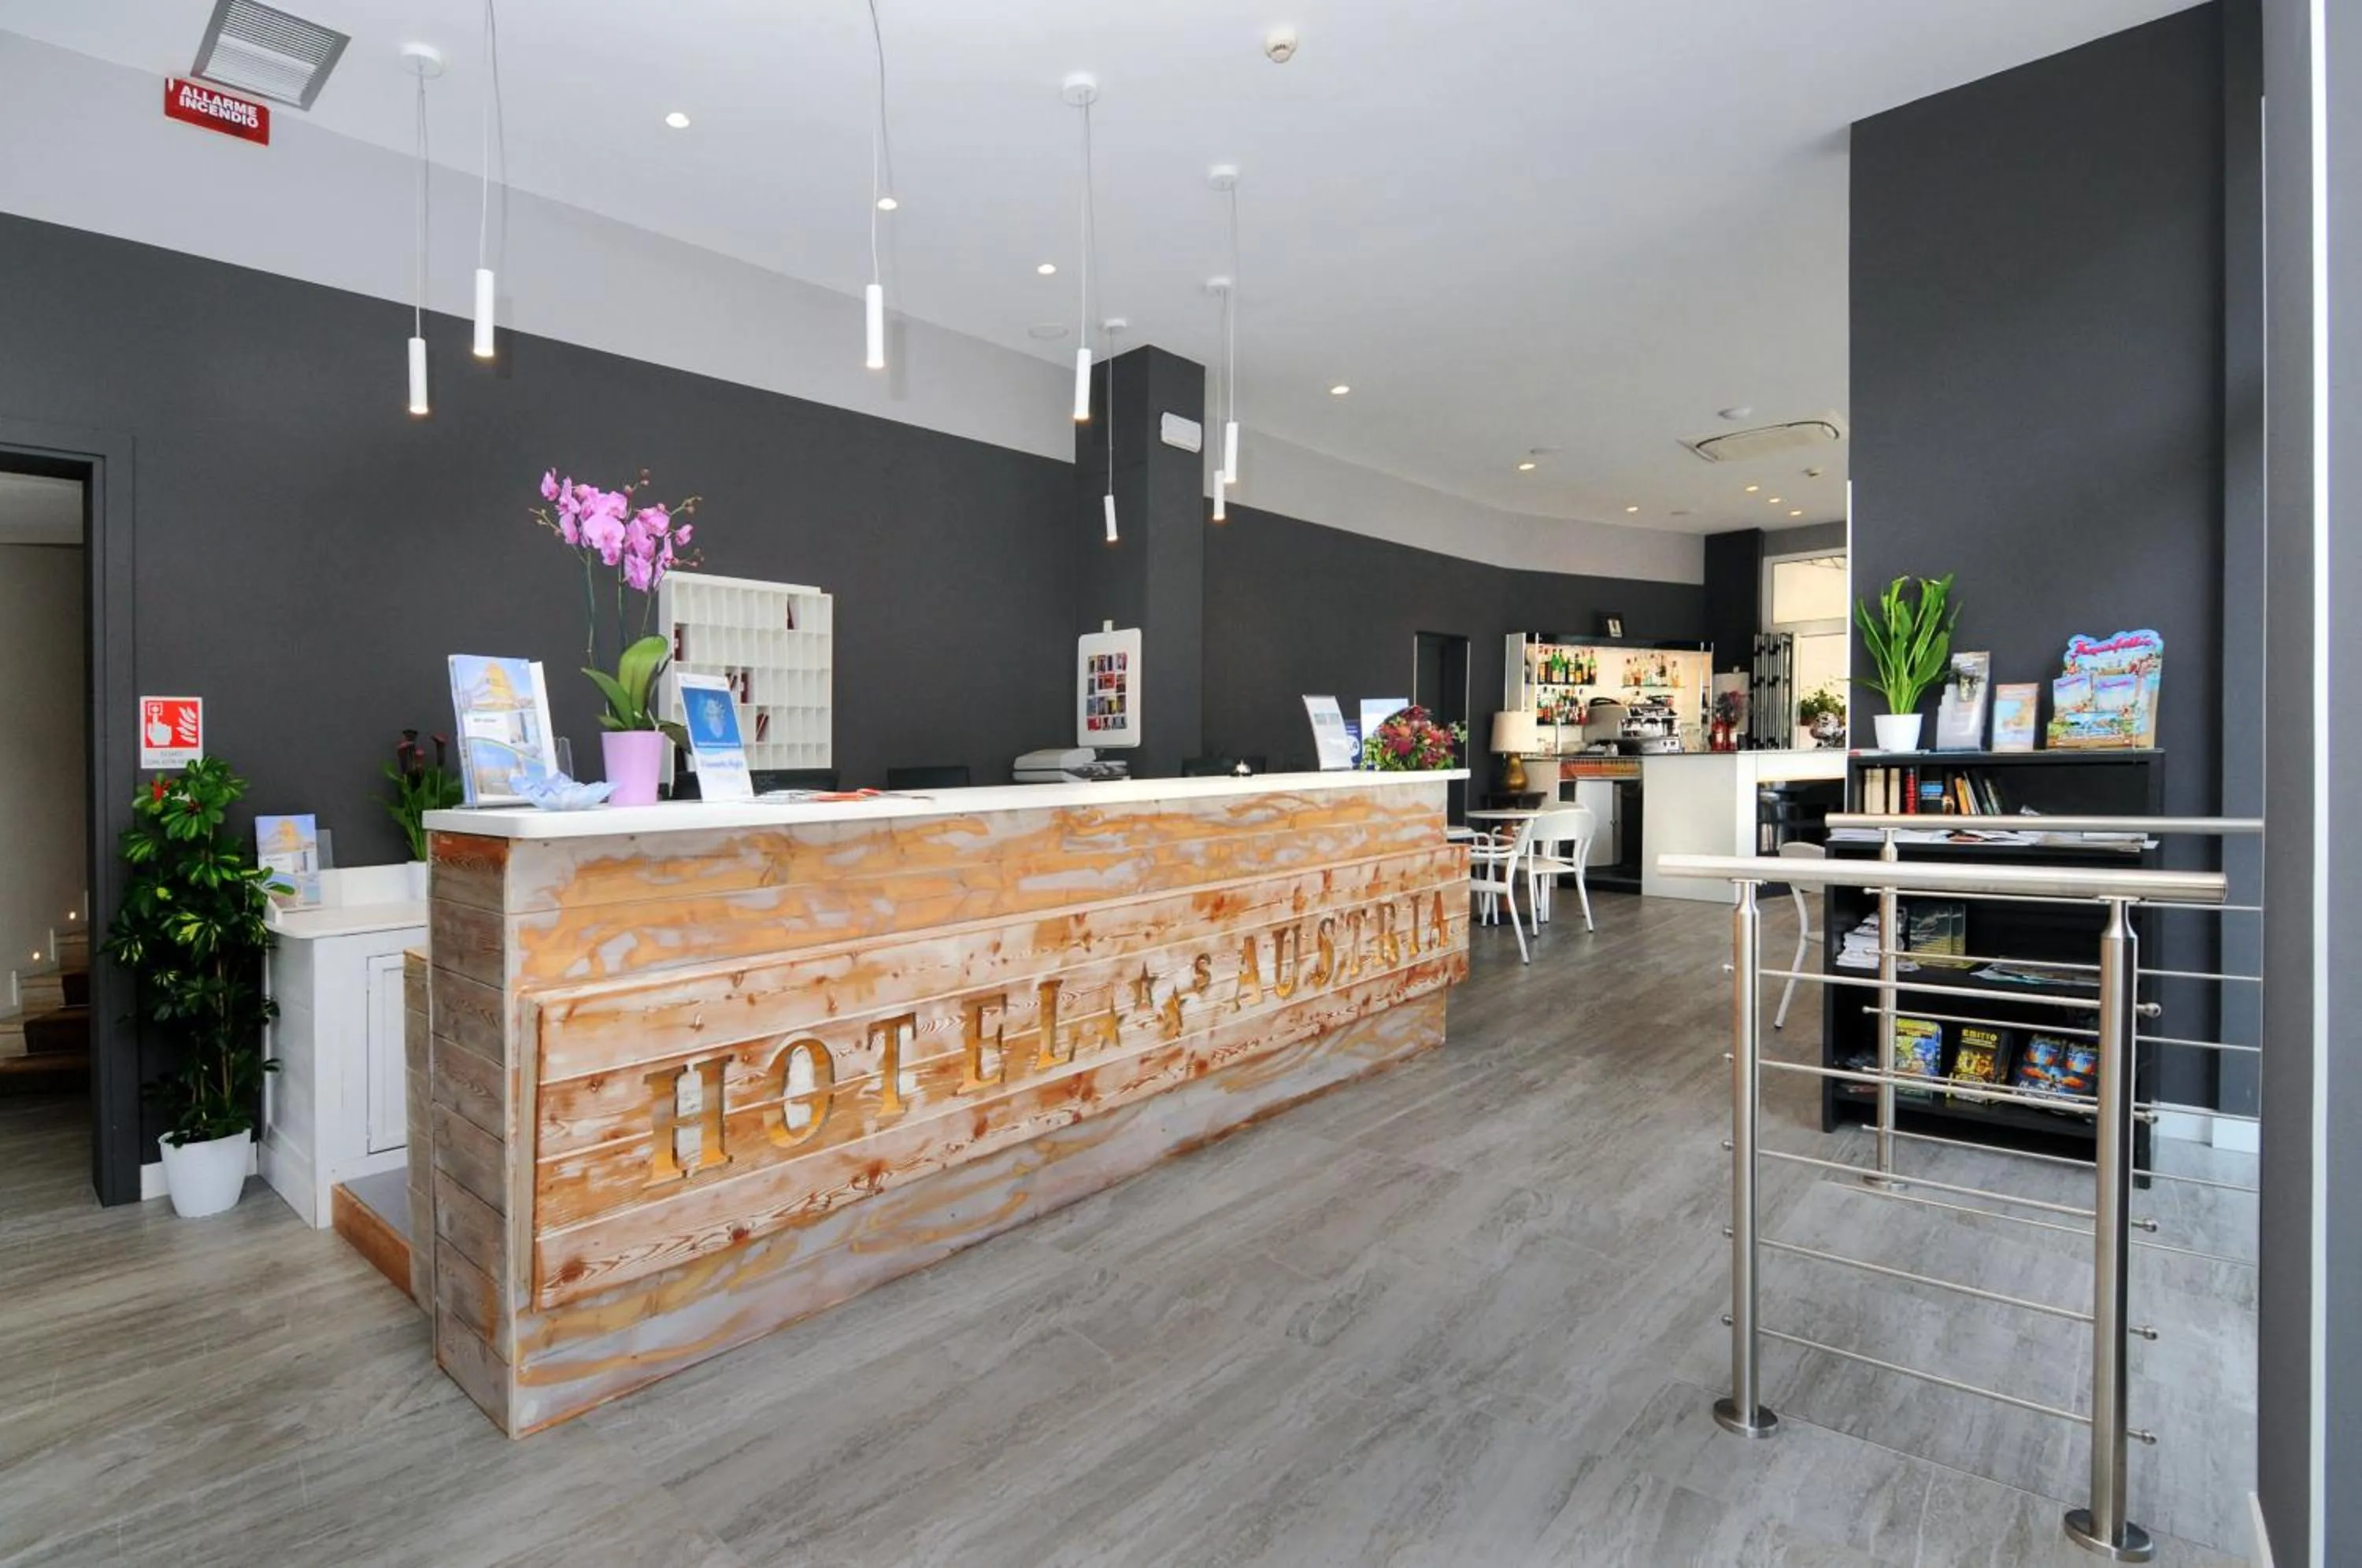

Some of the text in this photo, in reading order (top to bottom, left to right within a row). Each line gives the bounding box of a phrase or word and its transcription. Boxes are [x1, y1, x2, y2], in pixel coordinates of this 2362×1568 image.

[179, 94, 259, 128] INCENDIO
[180, 85, 258, 118] ALLARME
[642, 979, 1078, 1192] HOTEL
[1231, 890, 1450, 1014] AUSTRIA
